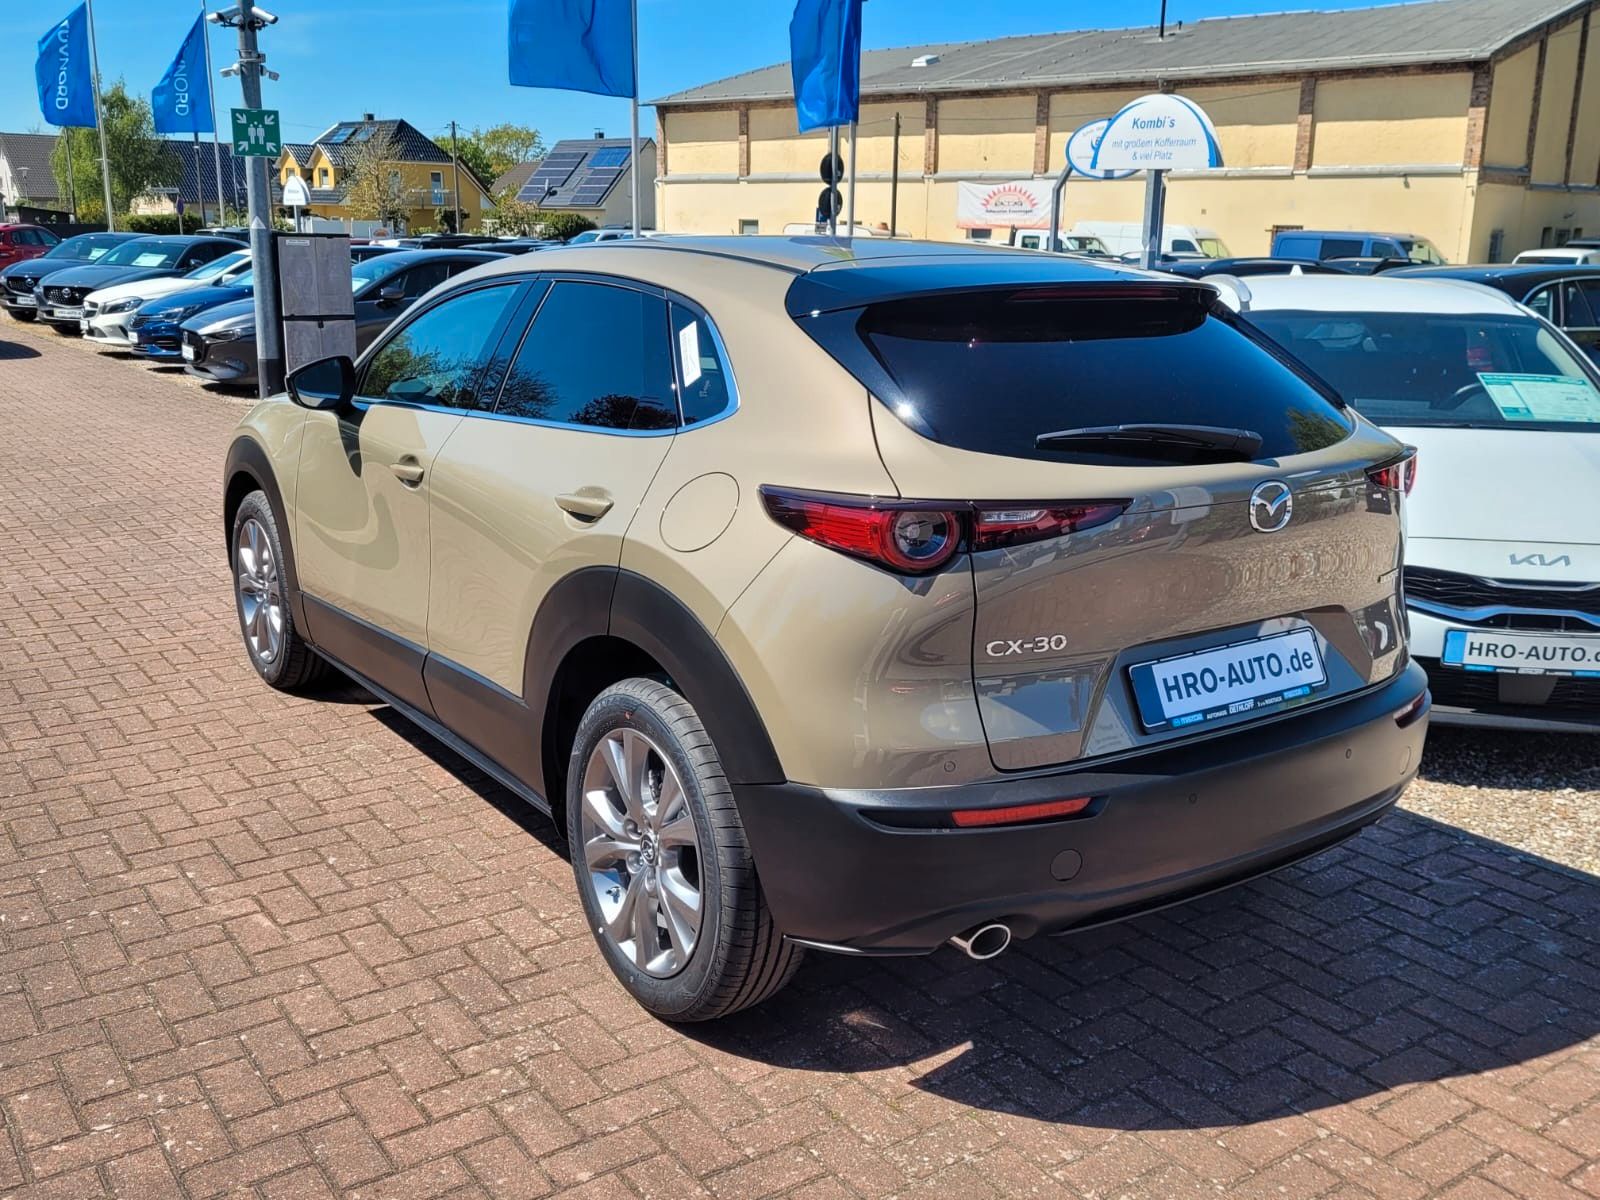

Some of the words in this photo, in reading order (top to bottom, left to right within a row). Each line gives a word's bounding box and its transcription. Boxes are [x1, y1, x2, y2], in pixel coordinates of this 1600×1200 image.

[1111, 138, 1123, 148] mit
[1123, 137, 1153, 151] großem
[1153, 136, 1198, 148] Kofferraum
[1131, 151, 1138, 161] &
[1139, 150, 1153, 161] viel
[1153, 150, 1174, 161] Platz
[985, 633, 1068, 658] CX-30
[1162, 648, 1314, 703] HRO-AUTO.de
